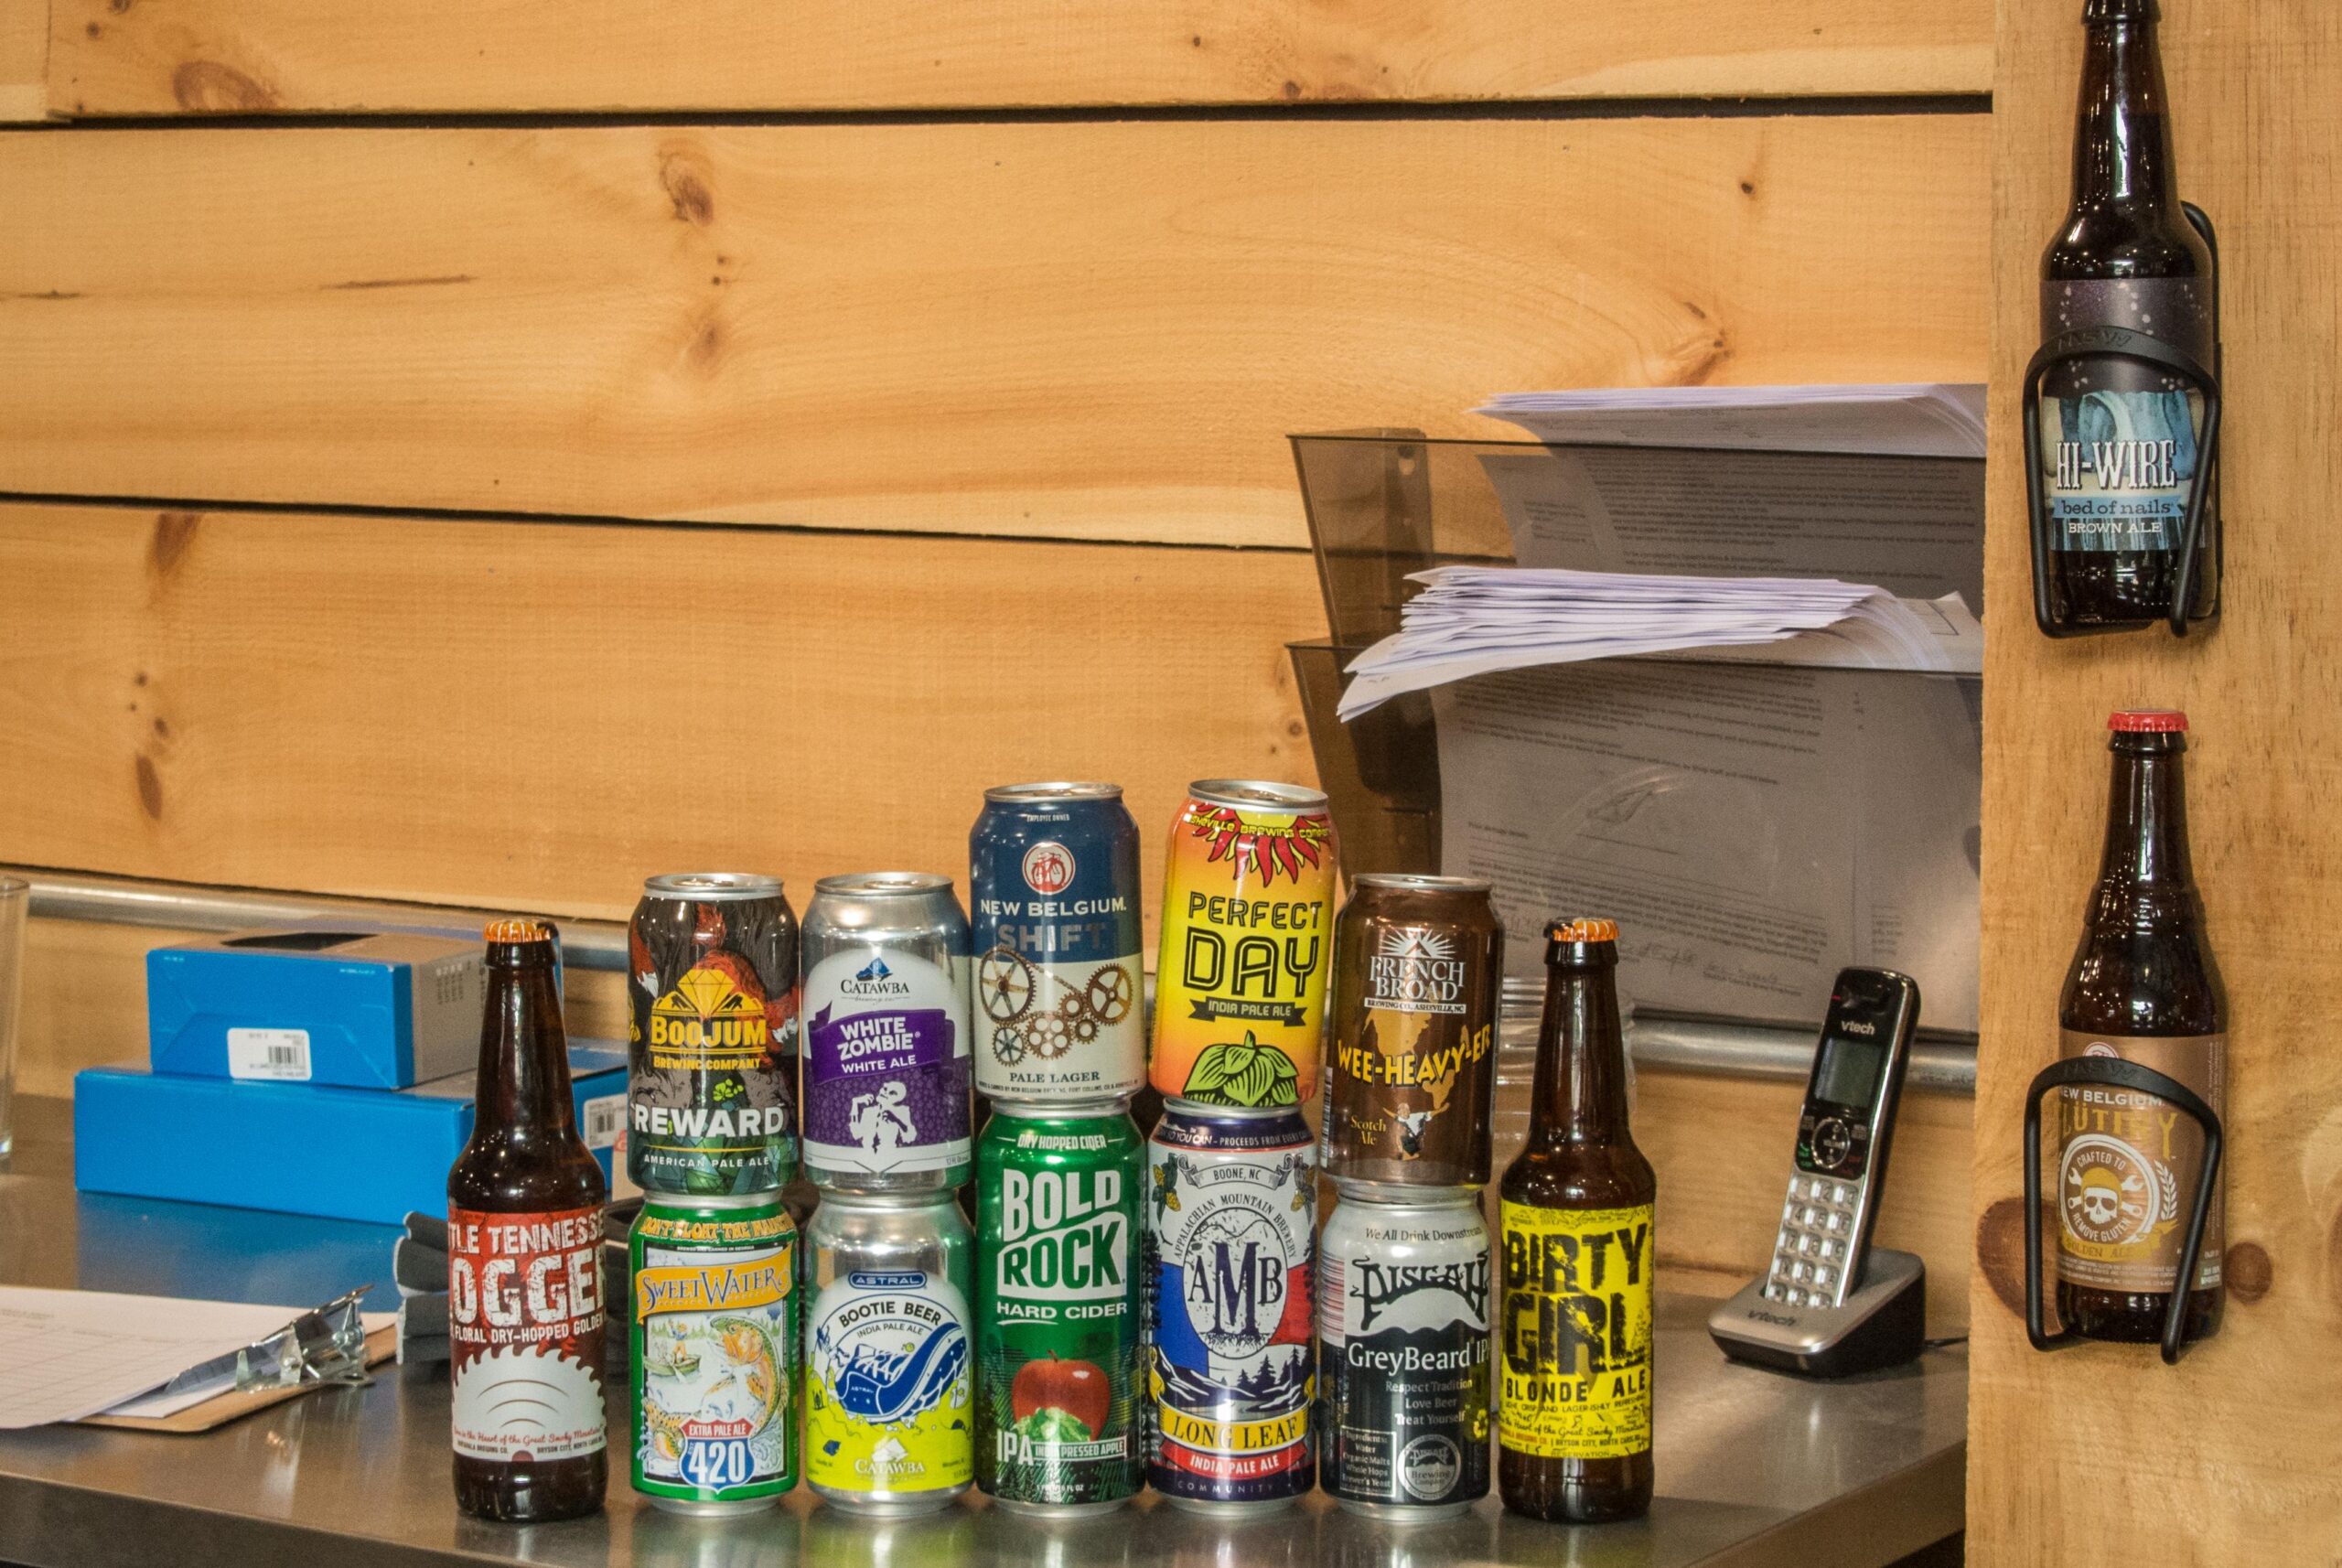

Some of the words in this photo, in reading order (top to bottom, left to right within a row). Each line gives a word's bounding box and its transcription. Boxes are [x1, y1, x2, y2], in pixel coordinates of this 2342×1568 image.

[2057, 438, 2177, 490] HI-WIRE
[2061, 499, 2094, 514] bed
[2097, 500, 2118, 514] of
[2121, 499, 2171, 515] nails
[2068, 522, 2122, 533] BROWN
[2127, 522, 2162, 533] ALE
[981, 898, 1021, 916] NEW
[1188, 891, 1323, 929] PERFECT
[997, 923, 1107, 952] SHIFT
[1183, 925, 1320, 998] DAY
[1370, 956, 1466, 988] FRENCH
[841, 980, 910, 994] CATAWBA
[1375, 976, 1459, 1002] BROAD
[1208, 999, 1239, 1015] INDIA
[1241, 1004, 1270, 1016] PALE
[1273, 1005, 1292, 1016] ALE
[651, 1015, 768, 1047] BOOJUM
[840, 1016, 907, 1041] WHITE
[1840, 1019, 1876, 1036] vtech
[836, 1033, 914, 1061] ZOMBIE
[653, 1057, 703, 1070] BREWING
[704, 1058, 761, 1070] COMPANY
[841, 1058, 886, 1074] WHITE
[889, 1054, 917, 1069] ALE
[1009, 1071, 1046, 1083] PALE
[1049, 1071, 1101, 1084] LAGER
[635, 1103, 784, 1138] REWARD
[1350, 1115, 1387, 1133] Scotch
[1016, 1133, 1037, 1148] DRY
[1038, 1134, 1080, 1150] HOPPED
[1079, 1134, 1107, 1149] CIDER
[1176, 1132, 1193, 1144] YOU
[1219, 1136, 1260, 1146] PROCEEDS
[1261, 1135, 1281, 1145] FROM
[1360, 1131, 1377, 1145] Ale
[643, 1154, 705, 1168] AMERICAN
[712, 1159, 743, 1168] PALE
[748, 1156, 770, 1167] ALE
[2076, 1151, 2112, 1167] CRAFTED
[2113, 1155, 2127, 1171] TO
[1213, 1167, 1246, 1181] BOONE,
[1249, 1167, 1262, 1181] NC
[1003, 1168, 1122, 1242] BOLD
[1174, 1197, 1217, 1259] APPALACHIAN
[1219, 1193, 1275, 1216] MOUNTAIN
[1273, 1212, 1297, 1259] BREWERY
[1366, 1228, 1381, 1240] We
[1382, 1230, 1398, 1240] All
[1401, 1230, 1431, 1241] Drink
[2072, 1212, 2100, 1242] REMOVE
[2100, 1217, 2133, 1242] GLUTEN
[1004, 1220, 1122, 1290] ROCK
[855, 1274, 920, 1285] ASTRAL
[1187, 1241, 1284, 1336] AMB
[1349, 1246, 1490, 1332] PISGAH
[838, 1301, 897, 1328] BOOTIE
[903, 1301, 942, 1326] BEER
[996, 1301, 1058, 1320] HARD
[1064, 1302, 1128, 1320] CIDER
[1746, 1309, 1799, 1328] vtech
[454, 1325, 488, 1344] FLORAL
[490, 1323, 570, 1344] DRY-HOPPED
[856, 1325, 882, 1339] INDIA
[883, 1323, 906, 1332] PALE
[906, 1324, 924, 1337] ALE
[1505, 1292, 1647, 1376] GIRL
[1348, 1341, 1472, 1377] GreyBeard
[1385, 1380, 1429, 1395] Respect
[1430, 1379, 1474, 1392] Tradition
[1506, 1377, 1589, 1403] BLONDE
[1611, 1369, 1647, 1399] ALE
[1405, 1398, 1432, 1410] Love
[1434, 1397, 1458, 1409] Beer
[1542, 1405, 1559, 1413] AND
[1394, 1412, 1424, 1426] Treat
[1427, 1410, 1467, 1425] Yourself
[478, 1432, 499, 1443] Heart
[500, 1434, 508, 1445] of
[689, 1423, 712, 1436] EXTRA
[713, 1424, 733, 1436] PALE
[733, 1423, 747, 1435] ALE
[1173, 1415, 1232, 1450] LONG
[1243, 1416, 1298, 1450] LEAF
[996, 1429, 1035, 1466] IPA
[1060, 1444, 1100, 1457] PRESSED
[1100, 1441, 1124, 1455] APPLE
[688, 1440, 747, 1484] 420
[854, 1457, 926, 1475] CATAWBA
[1189, 1455, 1223, 1474] INDIA
[1227, 1460, 1257, 1475] PALE
[1259, 1455, 1281, 1472] ALE
[1177, 1480, 1273, 1494] COMMUNITY
